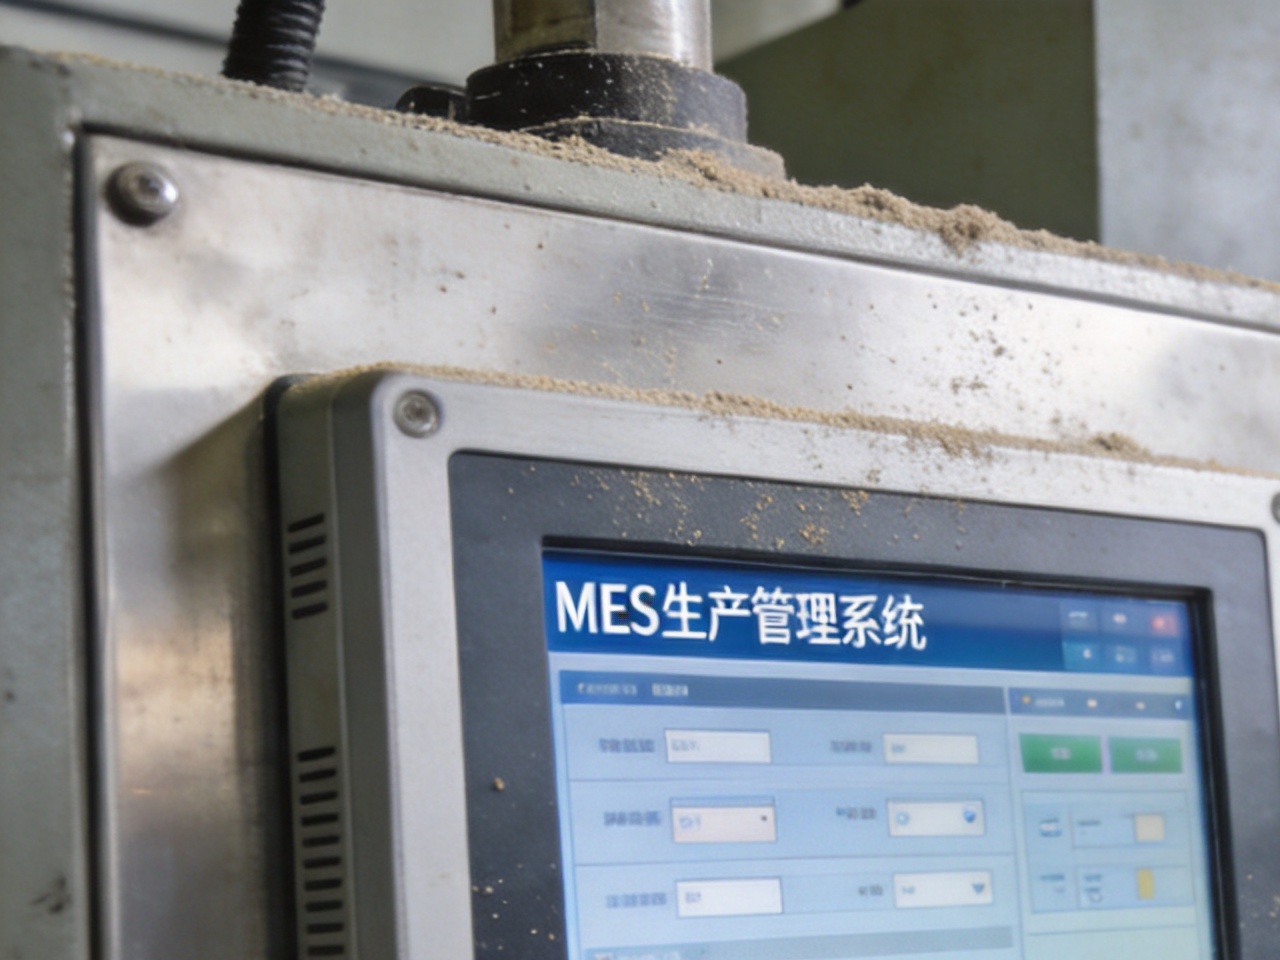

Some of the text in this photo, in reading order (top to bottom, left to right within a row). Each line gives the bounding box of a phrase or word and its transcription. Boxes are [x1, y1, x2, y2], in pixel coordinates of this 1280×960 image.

[555, 581, 926, 649] MES生产管理系统
